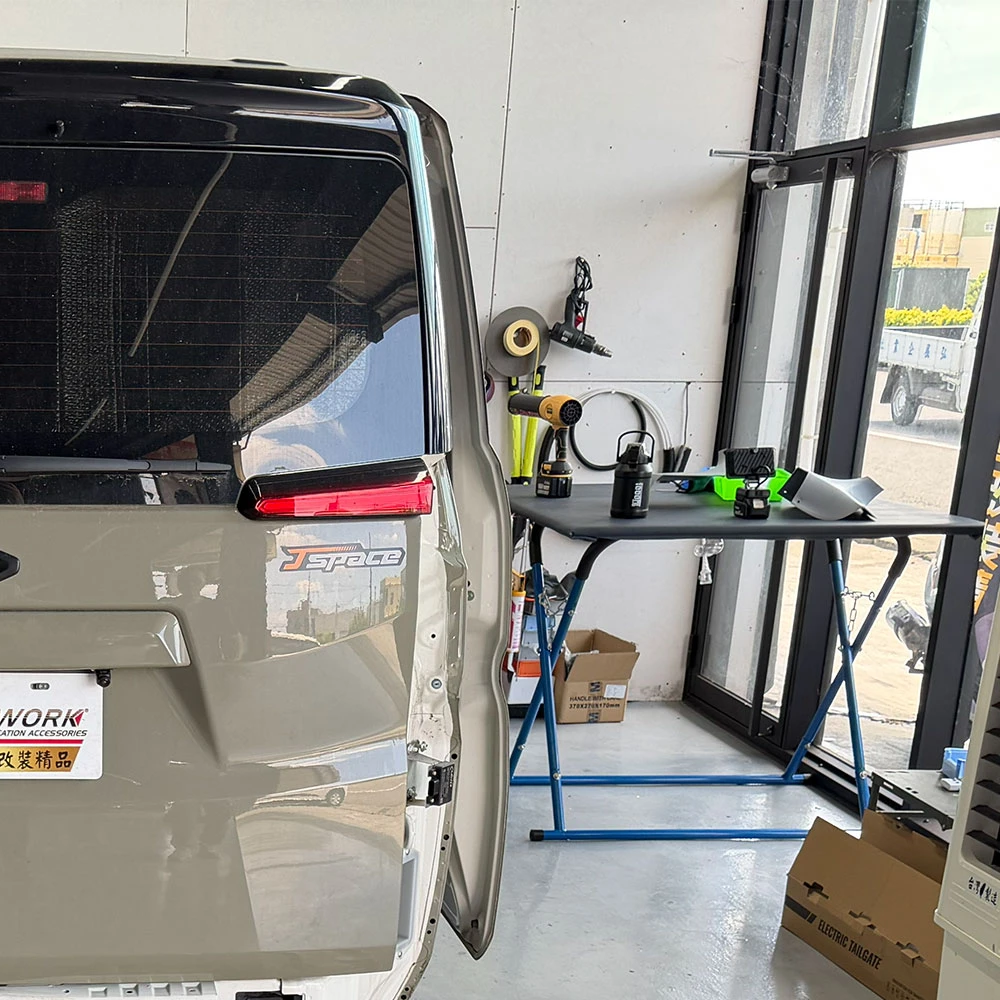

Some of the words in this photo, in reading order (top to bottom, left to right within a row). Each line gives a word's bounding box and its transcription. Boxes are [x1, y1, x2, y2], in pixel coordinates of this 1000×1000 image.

[27, 729, 88, 737] ACCESSORIES
[818, 919, 849, 948] ELECTRIC
[848, 940, 883, 970] TAILGATE
